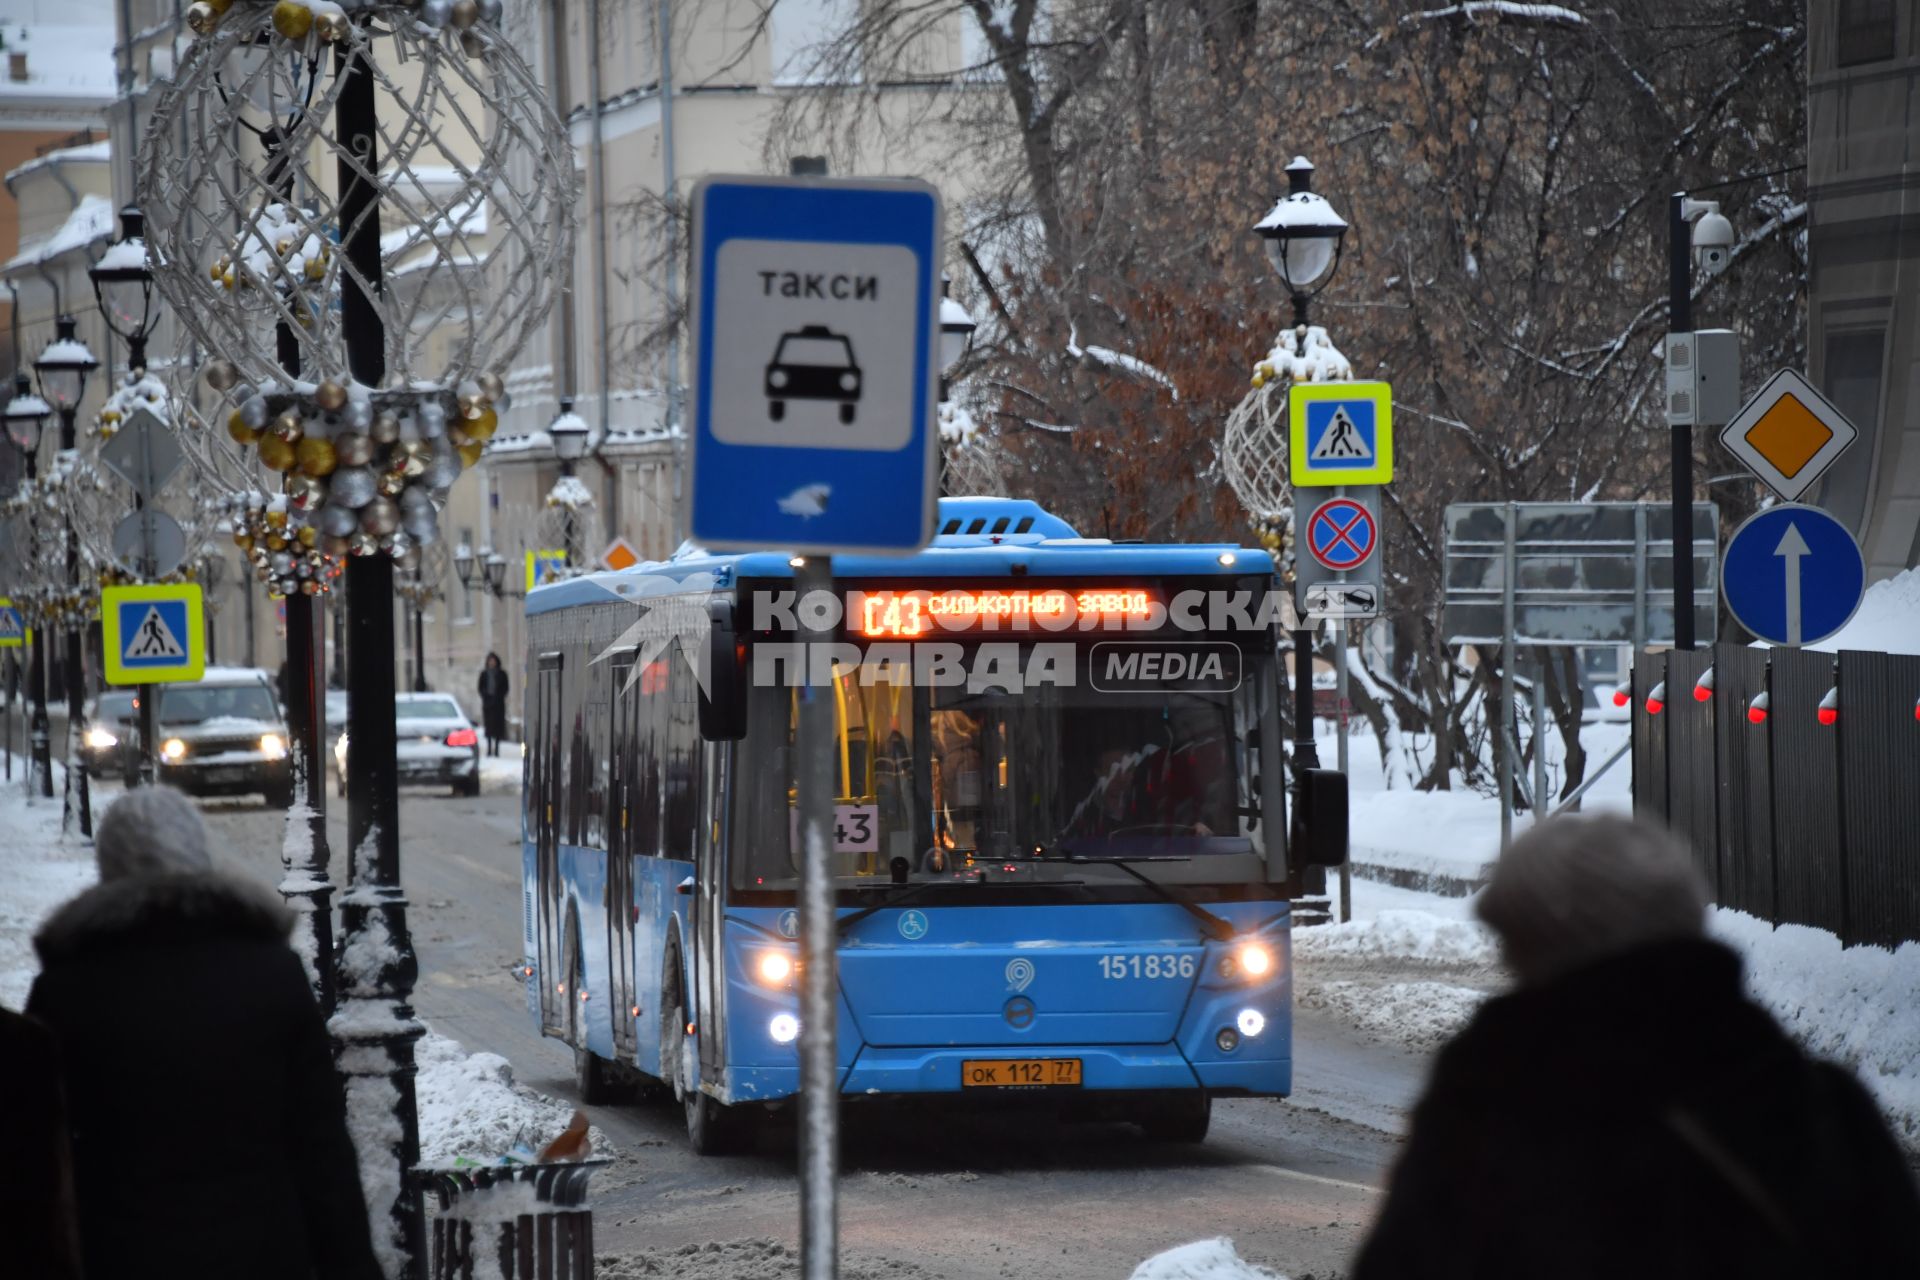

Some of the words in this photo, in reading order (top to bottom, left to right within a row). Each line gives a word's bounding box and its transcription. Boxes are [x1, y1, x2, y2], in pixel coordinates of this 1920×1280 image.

[757, 270, 879, 301] такси
[864, 596, 921, 636] С43
[1077, 593, 1149, 614] ЗАВОД
[1098, 954, 1195, 979] 151836
[1007, 1063, 1043, 1083] 112
[1055, 1061, 1075, 1077] 77
